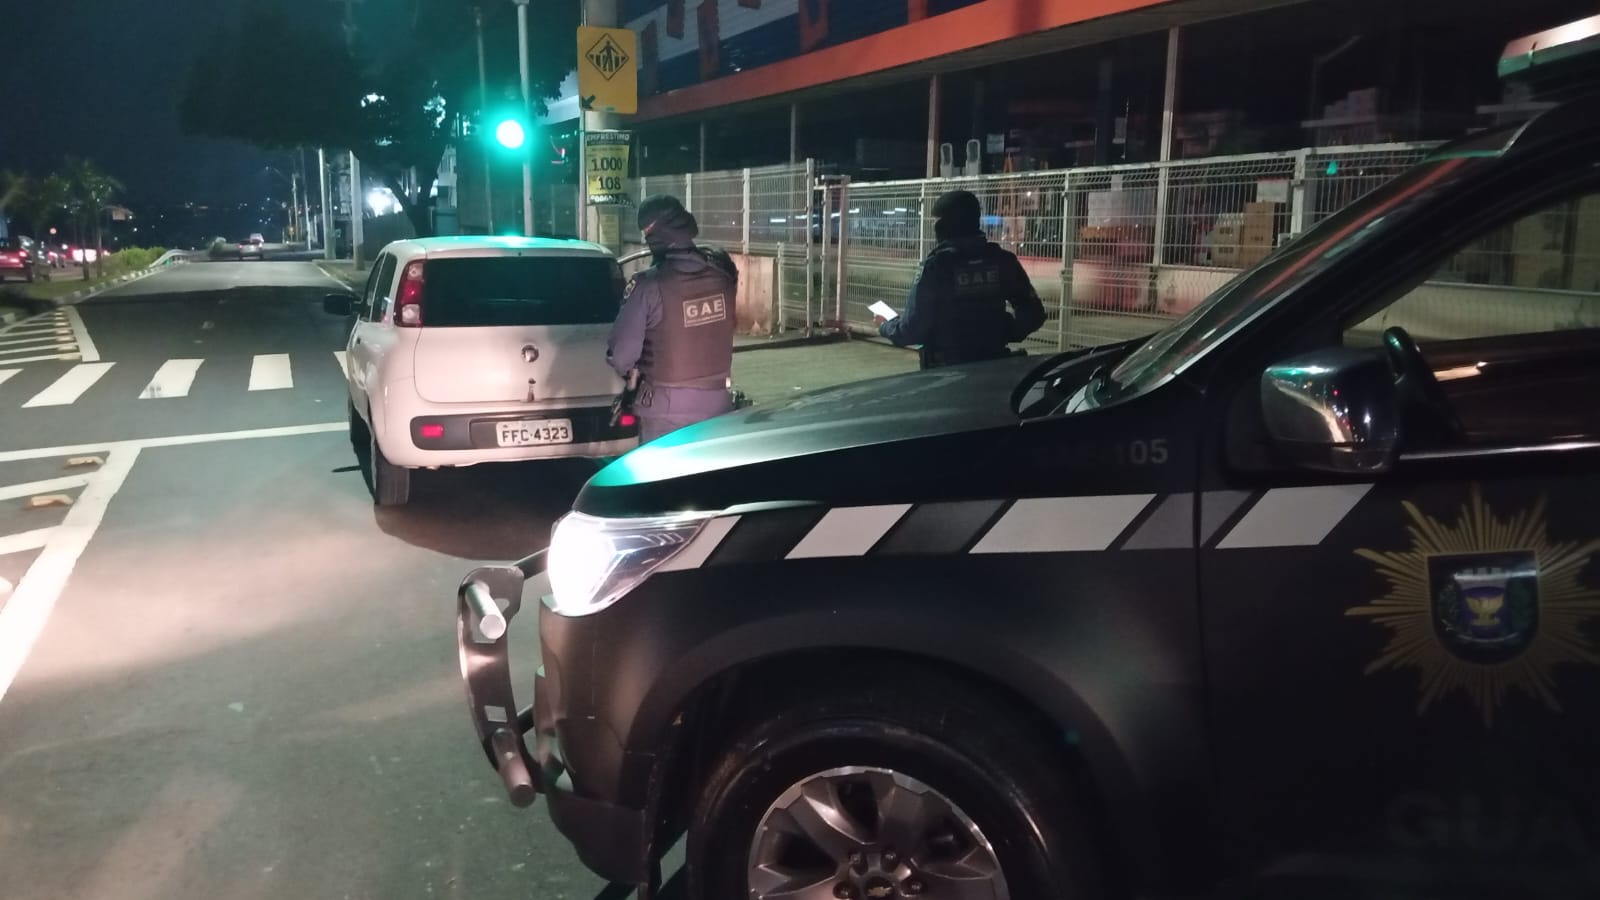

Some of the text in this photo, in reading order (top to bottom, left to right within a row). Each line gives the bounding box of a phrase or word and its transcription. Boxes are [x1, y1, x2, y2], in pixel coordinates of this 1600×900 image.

[599, 177, 621, 190] 108
[957, 271, 999, 285] GAE
[684, 298, 724, 318] GAE
